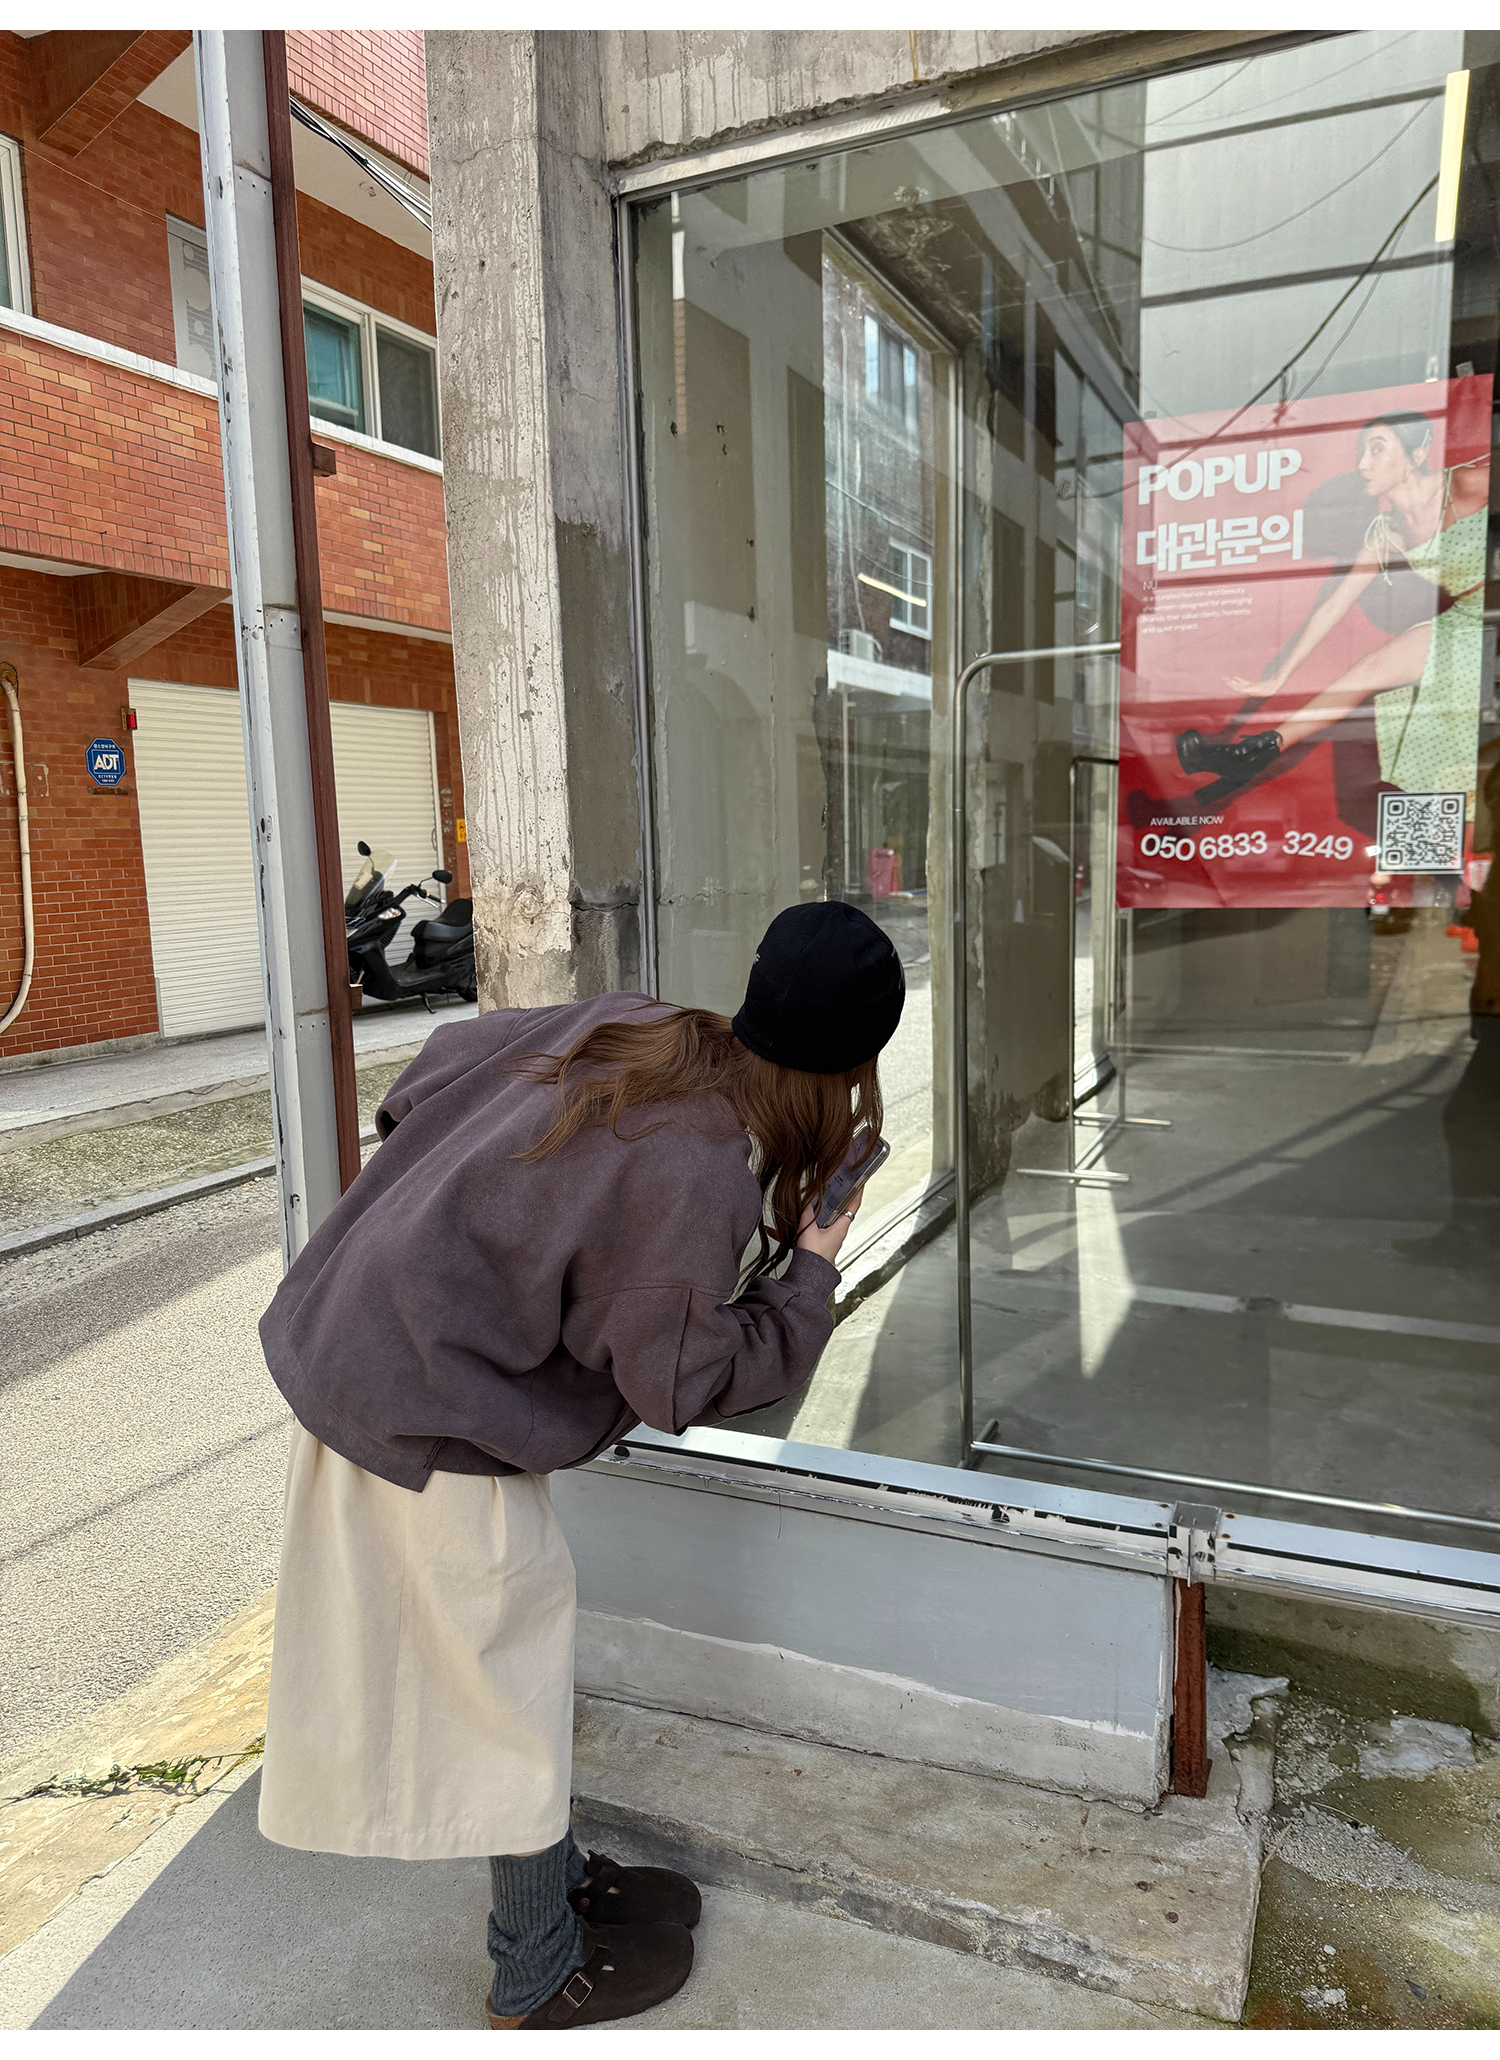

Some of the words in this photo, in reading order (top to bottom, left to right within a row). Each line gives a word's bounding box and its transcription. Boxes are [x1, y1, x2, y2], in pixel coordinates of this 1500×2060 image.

[1138, 449, 1302, 505] POPUP
[1136, 509, 1304, 572] 대관문의
[94, 754, 119, 770] ADT
[1149, 815, 1198, 826] AVAILABLE
[1199, 814, 1225, 825] NOW
[1140, 833, 1196, 862] 050
[1199, 830, 1268, 860] 6833
[1282, 830, 1353, 861] 3249
